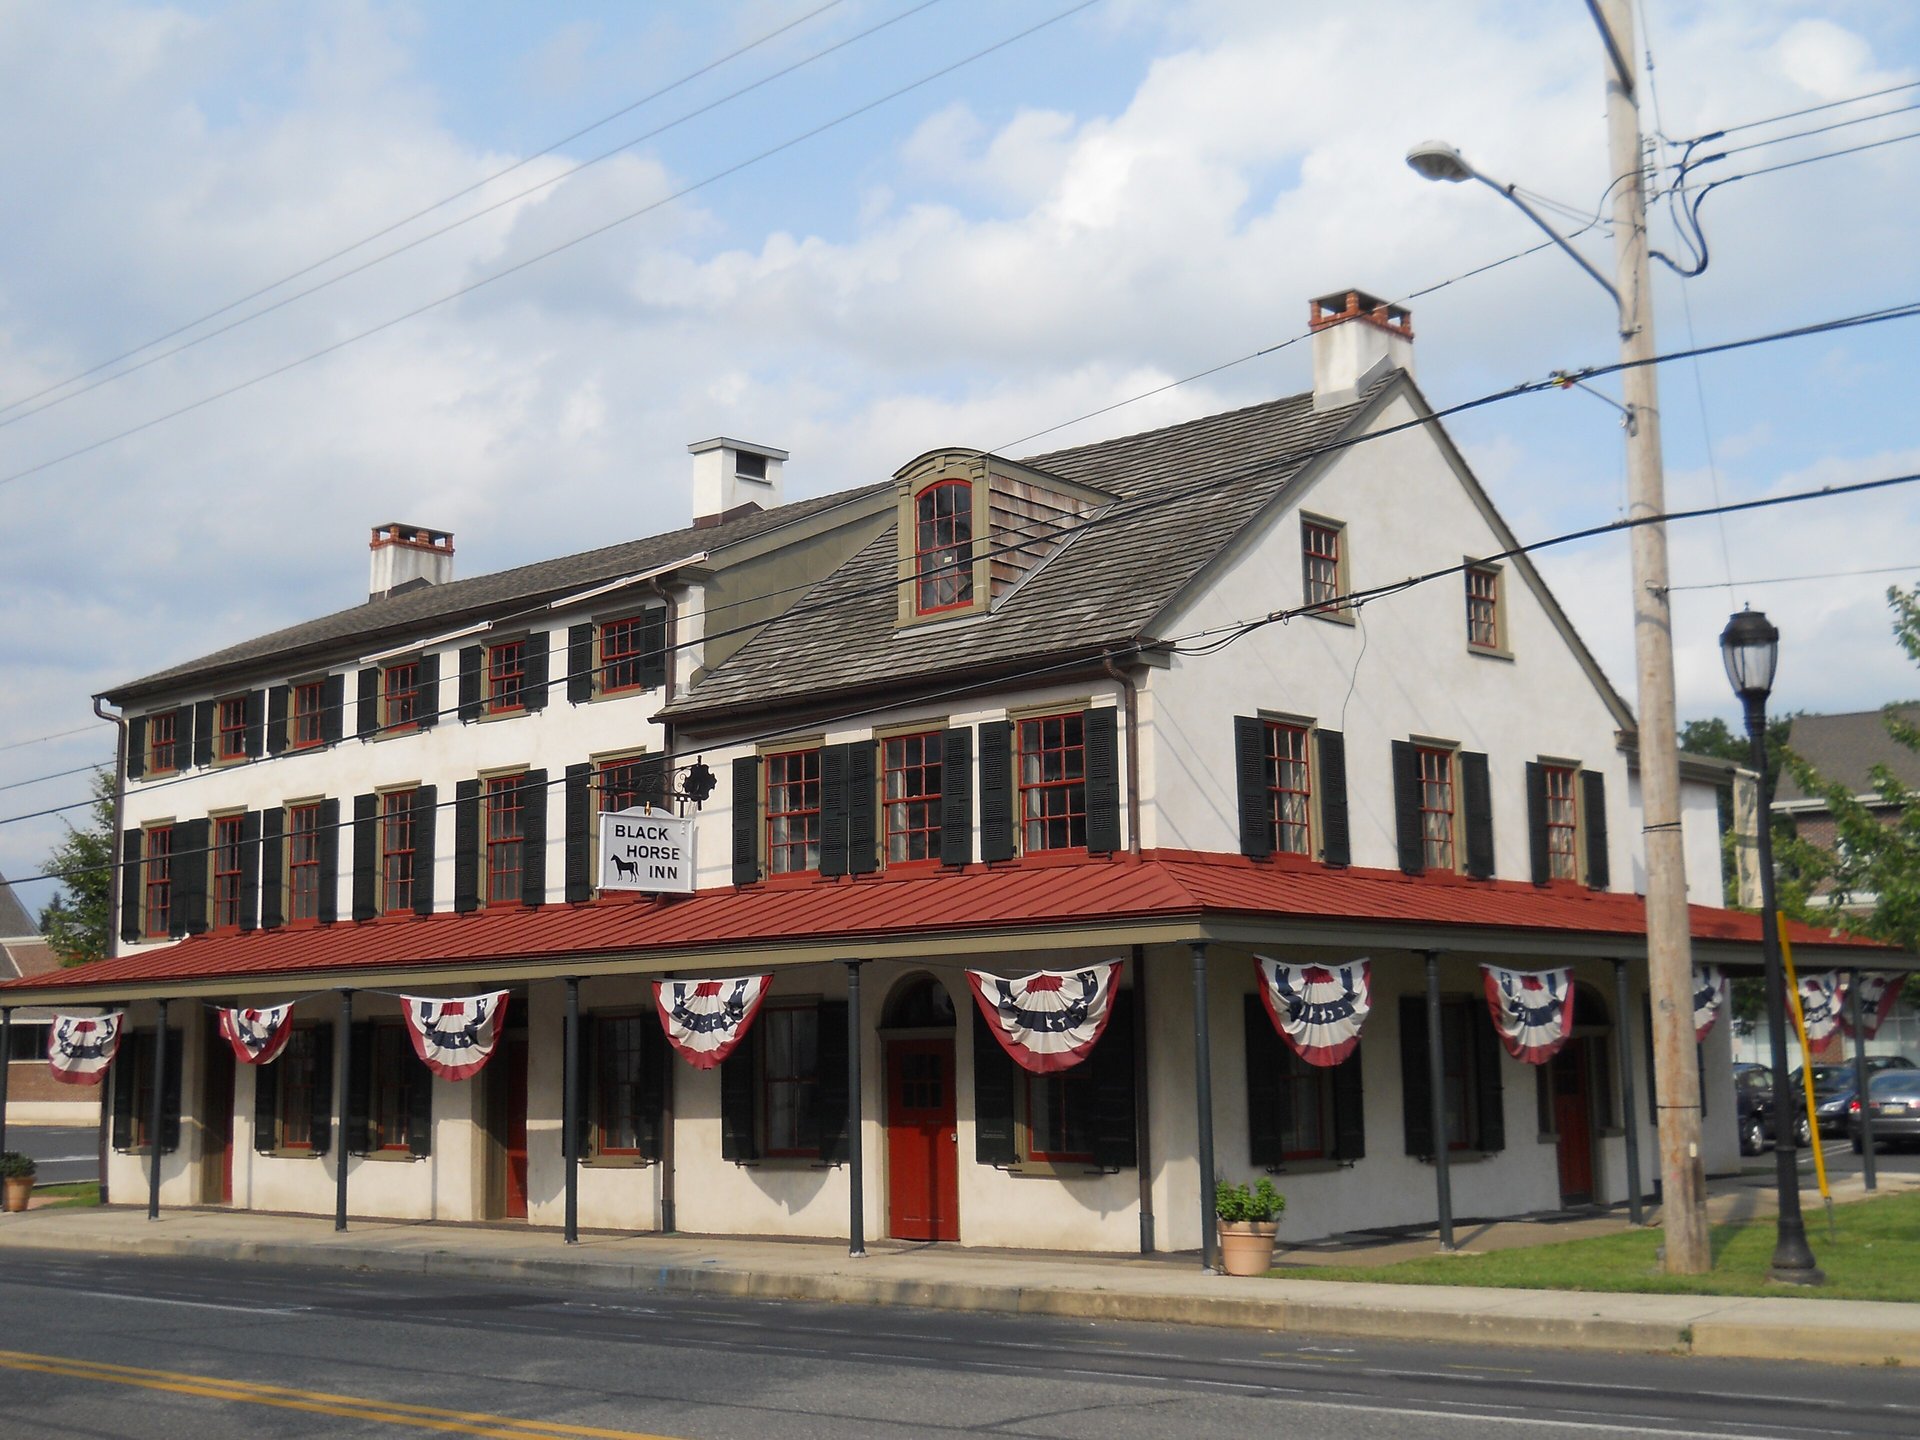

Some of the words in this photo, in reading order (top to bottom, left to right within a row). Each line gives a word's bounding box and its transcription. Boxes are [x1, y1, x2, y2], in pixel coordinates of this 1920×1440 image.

[615, 824, 669, 841] BLACK
[626, 844, 680, 860] HORSE
[649, 865, 678, 879] INN
